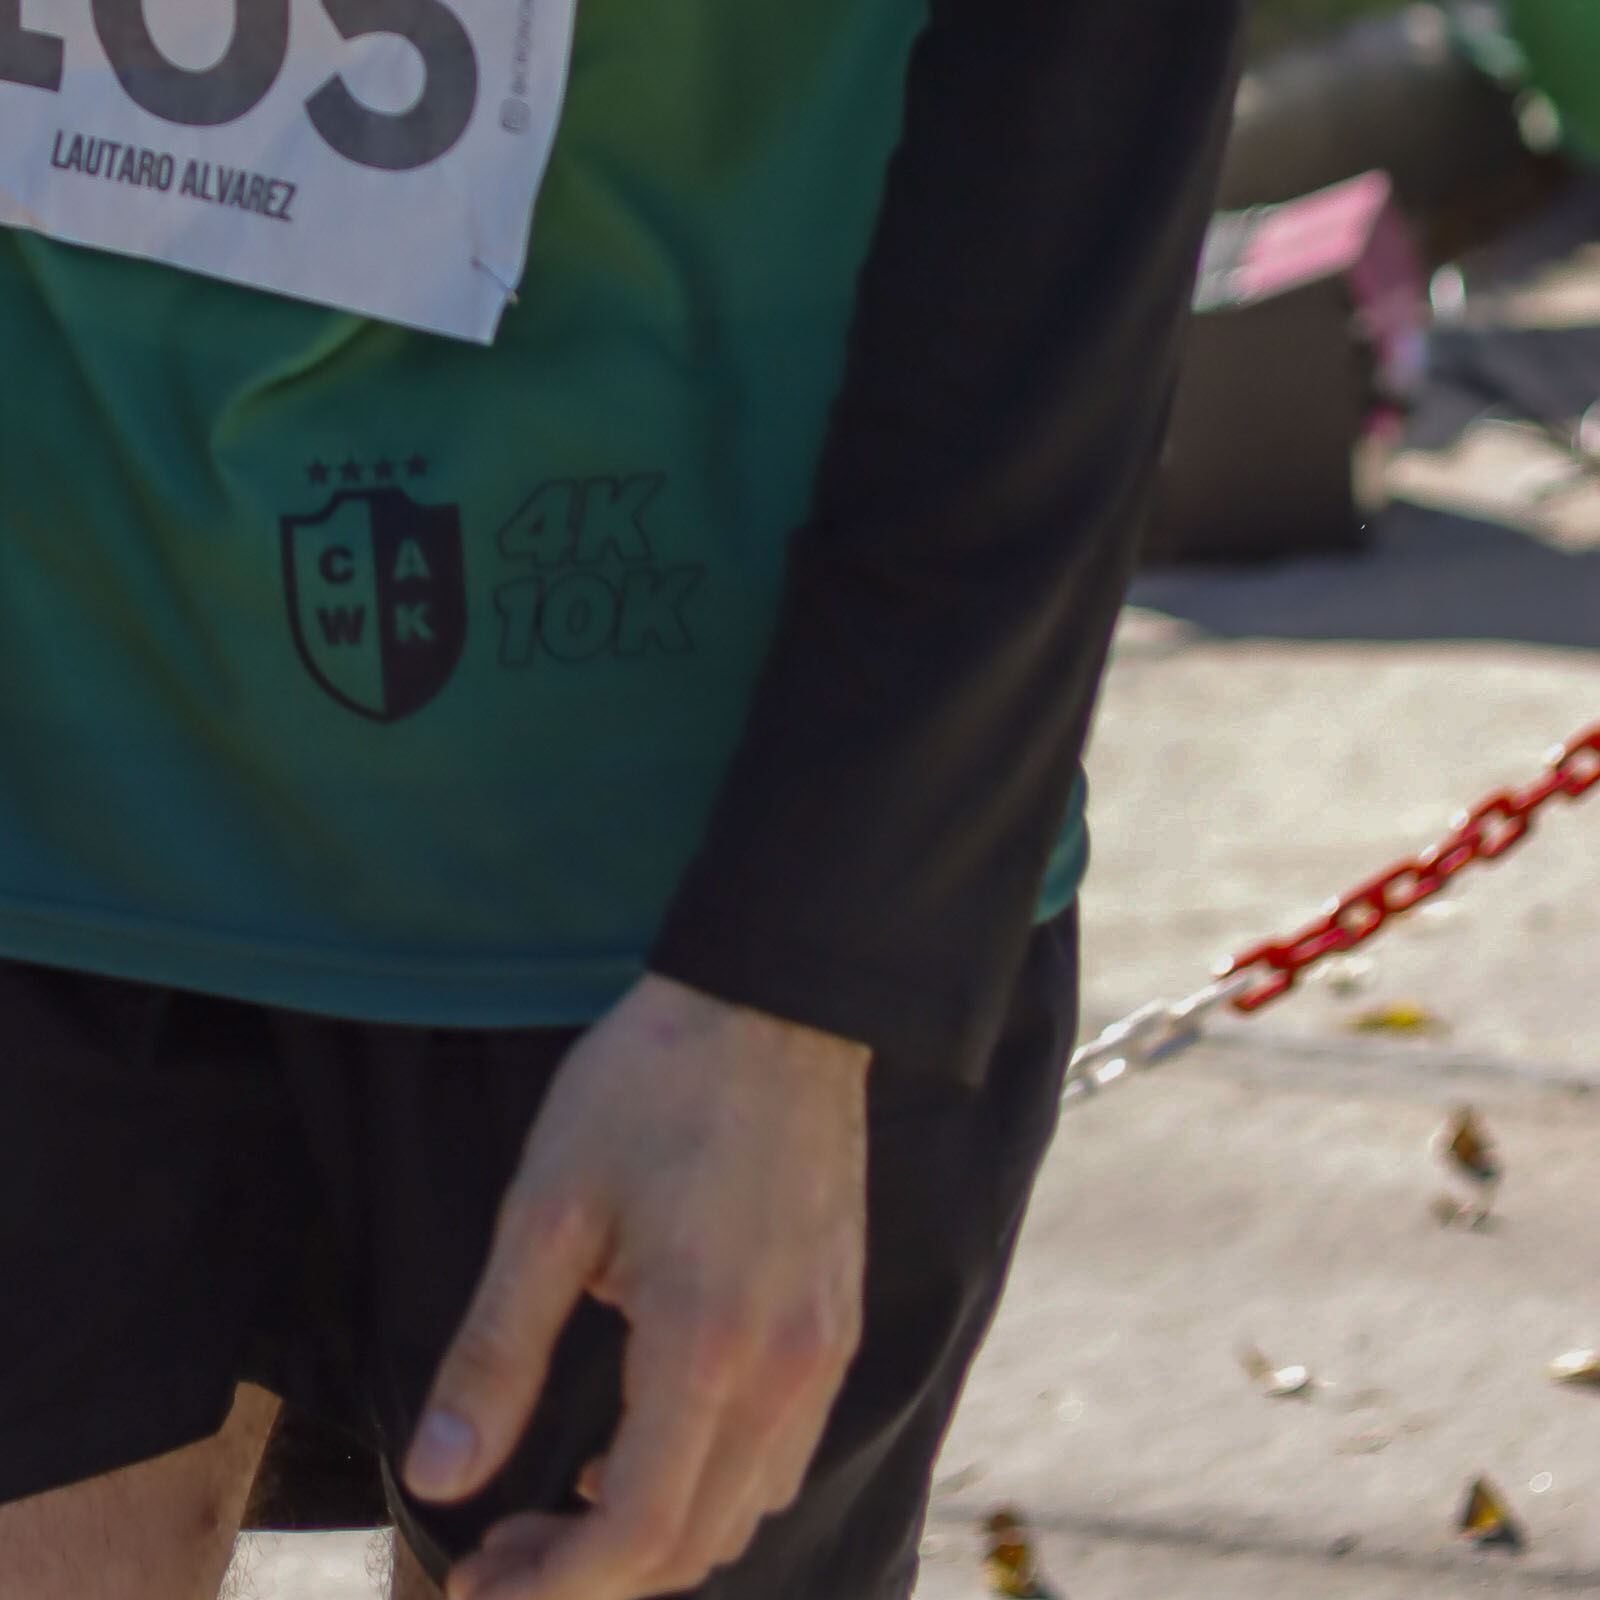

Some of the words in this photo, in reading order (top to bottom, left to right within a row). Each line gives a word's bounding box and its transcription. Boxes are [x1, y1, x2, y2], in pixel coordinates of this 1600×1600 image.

[50, 129, 175, 192] LAUTARO
[179, 158, 297, 222] ALVAREZ
[498, 471, 666, 567] 4K
[493, 563, 706, 669] 10K
